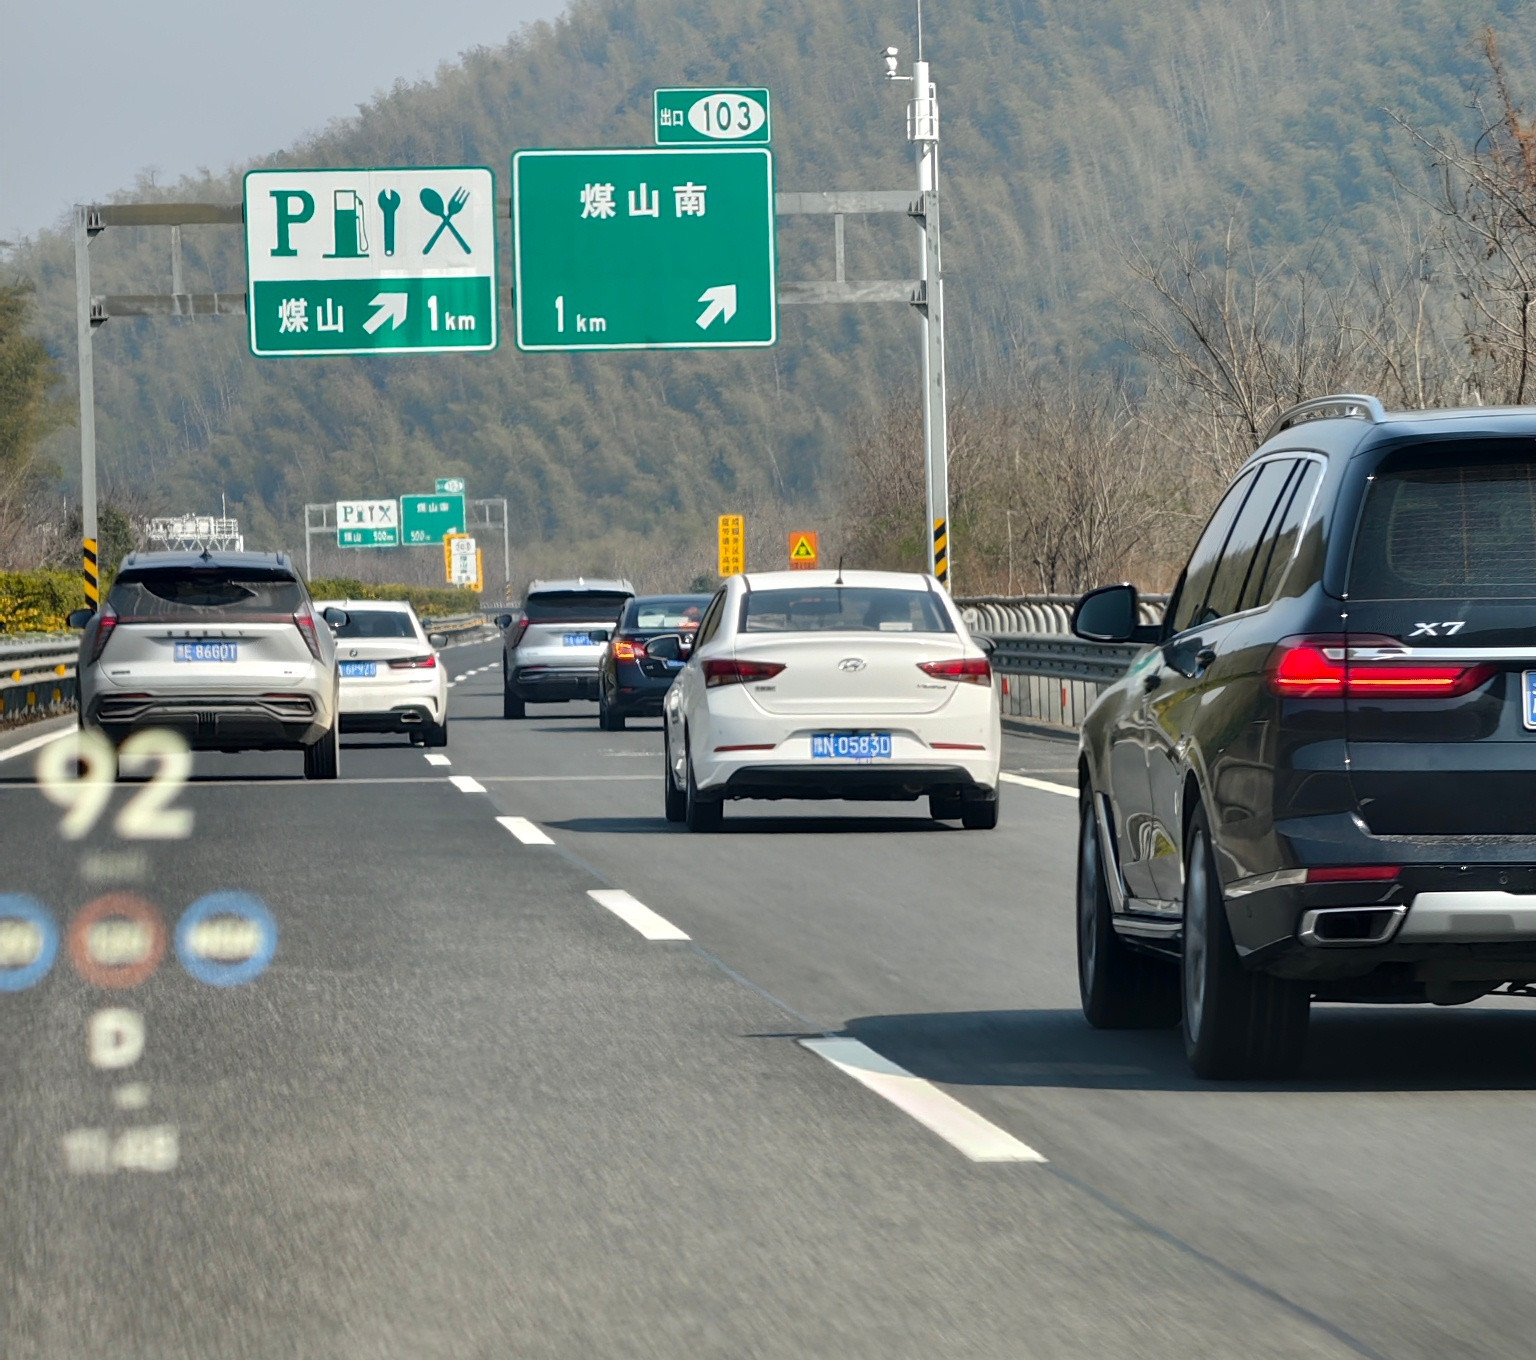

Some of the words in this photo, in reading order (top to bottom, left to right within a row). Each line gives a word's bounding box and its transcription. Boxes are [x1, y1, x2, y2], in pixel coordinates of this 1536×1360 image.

[660, 107, 684, 127] 出口
[703, 101, 751, 132] 103
[580, 181, 707, 220] 煤山南
[269, 190, 315, 257] P
[278, 297, 344, 334] 煤山
[1407, 621, 1466, 637] X7
[36, 728, 195, 839] 92
